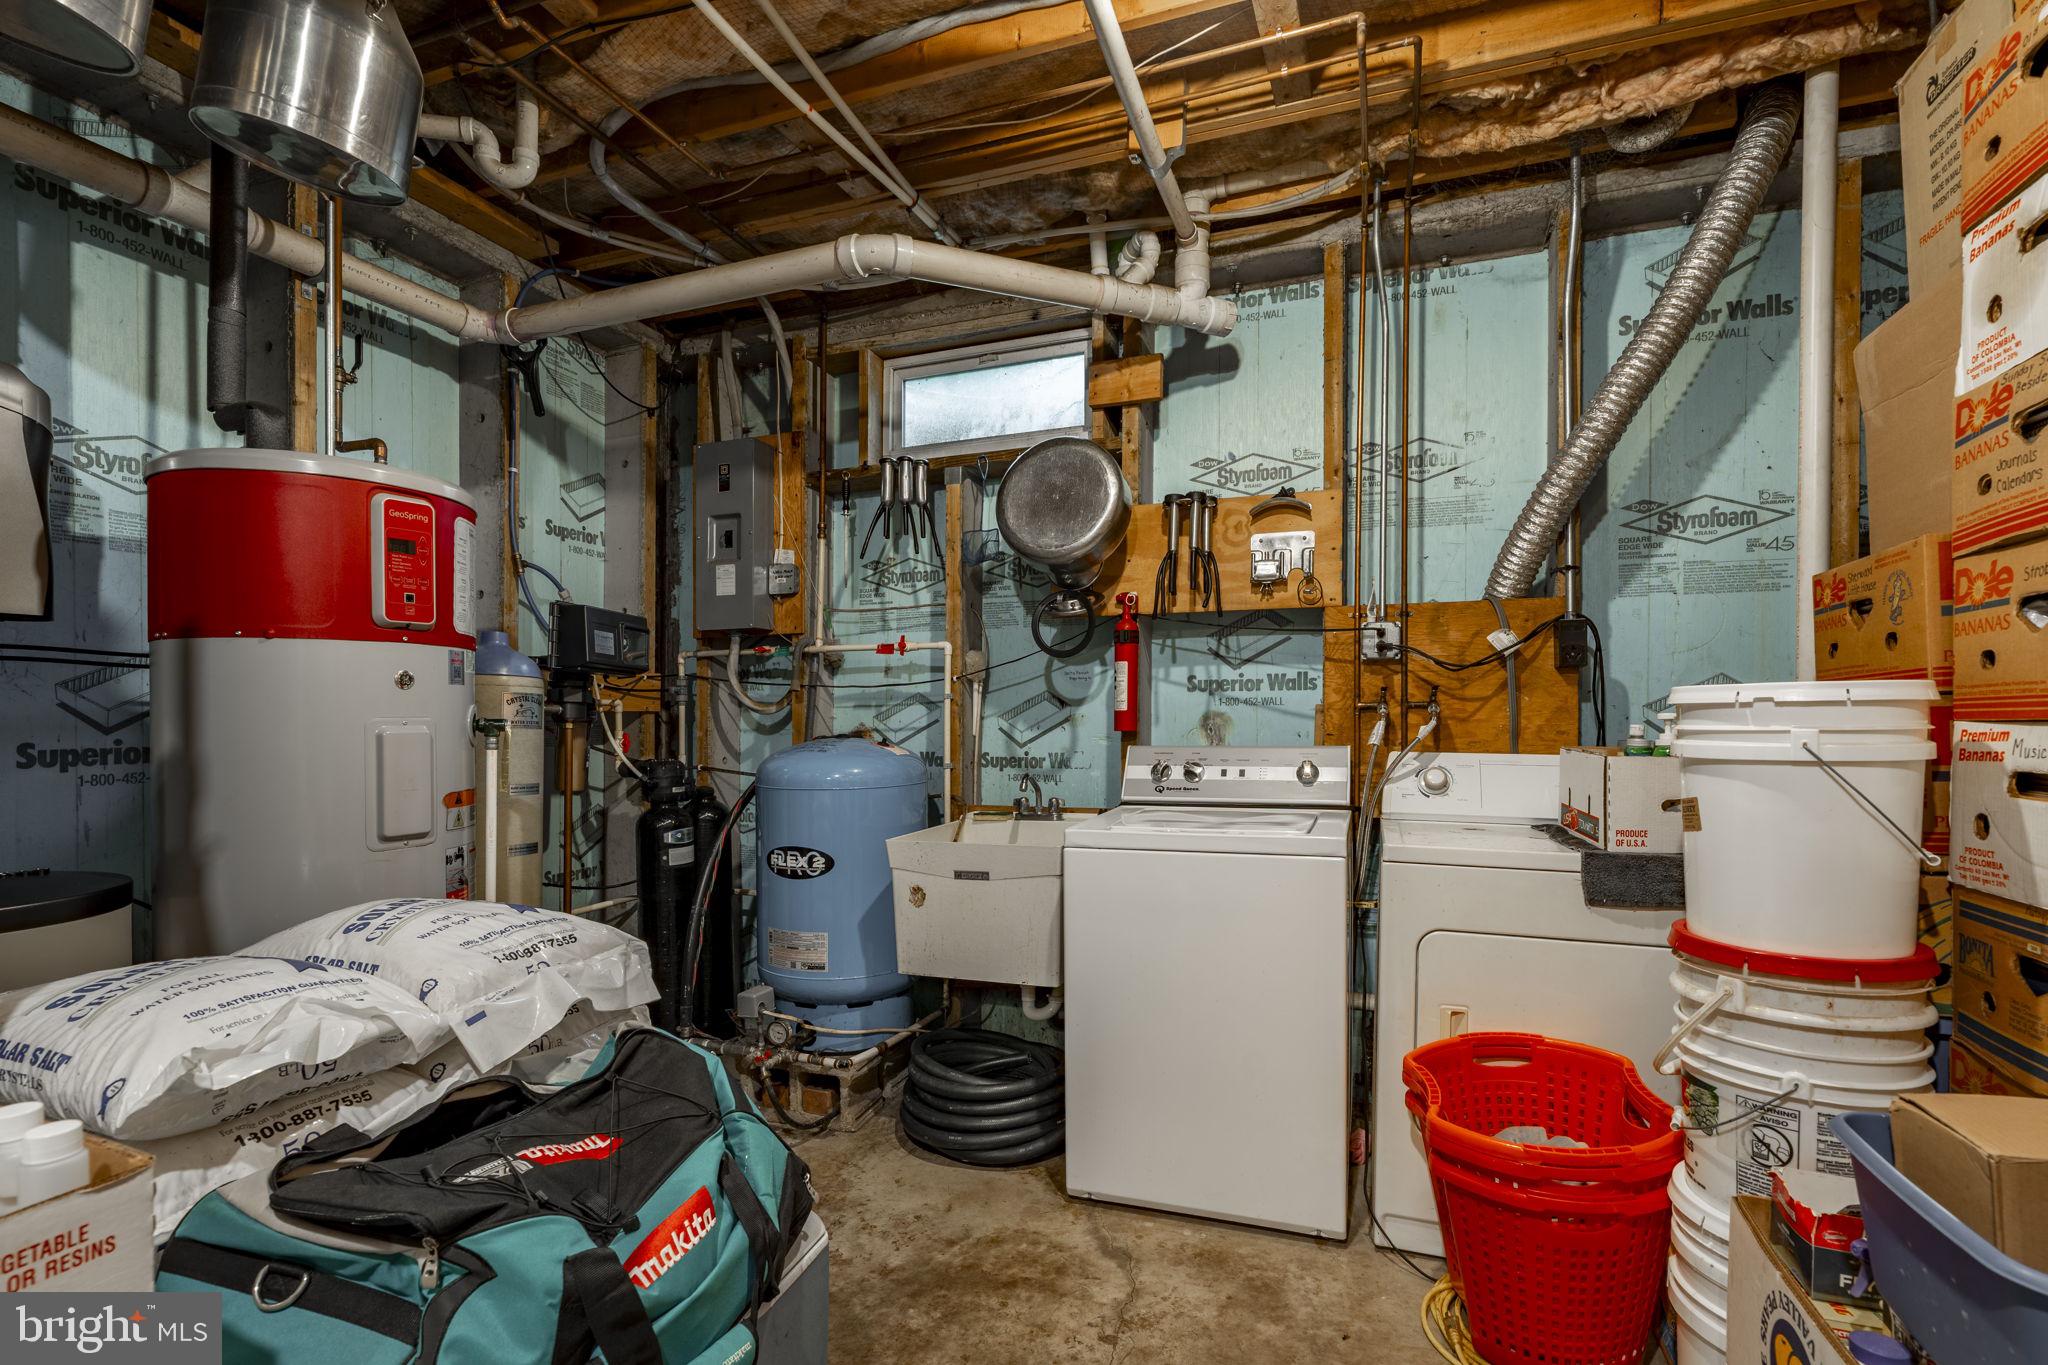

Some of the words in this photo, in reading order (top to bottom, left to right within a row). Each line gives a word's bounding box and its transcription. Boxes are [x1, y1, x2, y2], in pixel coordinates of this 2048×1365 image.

[1964, 31, 2021, 117] Dole
[1963, 76, 2018, 148] BANANAS
[14, 162, 156, 238] Superior
[1931, 178, 1944, 200] MADE
[1932, 187, 1948, 214] PATENT
[1970, 198, 2022, 244] Premium
[76, 220, 188, 272] 1-800-452-WALL
[1968, 219, 2017, 264] Bananas
[1267, 282, 1320, 305] Walls
[1726, 293, 1795, 321] Walls
[1971, 353, 1979, 364] OF
[1981, 332, 2016, 359] COLOMBIA
[1978, 326, 2008, 350] PRODUCT
[1955, 380, 2014, 440] Dole
[1954, 429, 2010, 471] BANANAS
[1996, 449, 2038, 472] Journals
[53, 474, 83, 487] WIDE
[1217, 462, 1293, 487] Styrofoam
[1996, 468, 2044, 494] Calendars
[388, 508, 429, 524] GeoSpring
[1631, 503, 1658, 512] DOW
[1656, 505, 1758, 534] Styrofoam
[545, 518, 599, 545] Superior
[1618, 536, 1653, 544] SQUARE
[1618, 543, 1641, 551] EDGE
[1642, 542, 1664, 550] WIDE
[880, 566, 940, 587] Styrofoam
[1955, 559, 2014, 607] Dole
[1813, 572, 1847, 609] Dole
[1816, 613, 1848, 633] BANANAS
[1954, 613, 2011, 638] BANANAS
[1187, 672, 1264, 696] Superior
[1266, 671, 1318, 691] Walls
[1218, 697, 1285, 706] 1-800-452-WALL
[1959, 728, 2011, 743] Premium
[981, 750, 1046, 772] Superior
[1959, 748, 2005, 762] Bananas
[1615, 829, 1648, 838] PRODUCE
[1626, 840, 1648, 848] U.S.A.
[770, 854, 809, 869] FLEX
[1959, 855, 1968, 864] OF
[1968, 857, 2004, 871] COLOMBIA
[1964, 846, 1995, 859] PRODUCT
[417, 923, 451, 941] WATER
[130, 989, 185, 1018] WATER
[186, 970, 274, 995] SOFTENERS
[161, 979, 192, 993] FOR
[197, 971, 225, 983] ALL
[183, 1005, 217, 1021] 100%
[218, 983, 298, 1010] SATISFACTION
[31, 1049, 74, 1074] SALT
[1753, 1103, 1799, 1121] WARNING
[1760, 1116, 1789, 1128] AVISO
[516, 1133, 614, 1161] makita
[0, 1223, 90, 1275] GETABLE
[630, 1206, 718, 1289] makita
[6, 1268, 36, 1294] OR
[45, 1235, 116, 1281] RESINS
